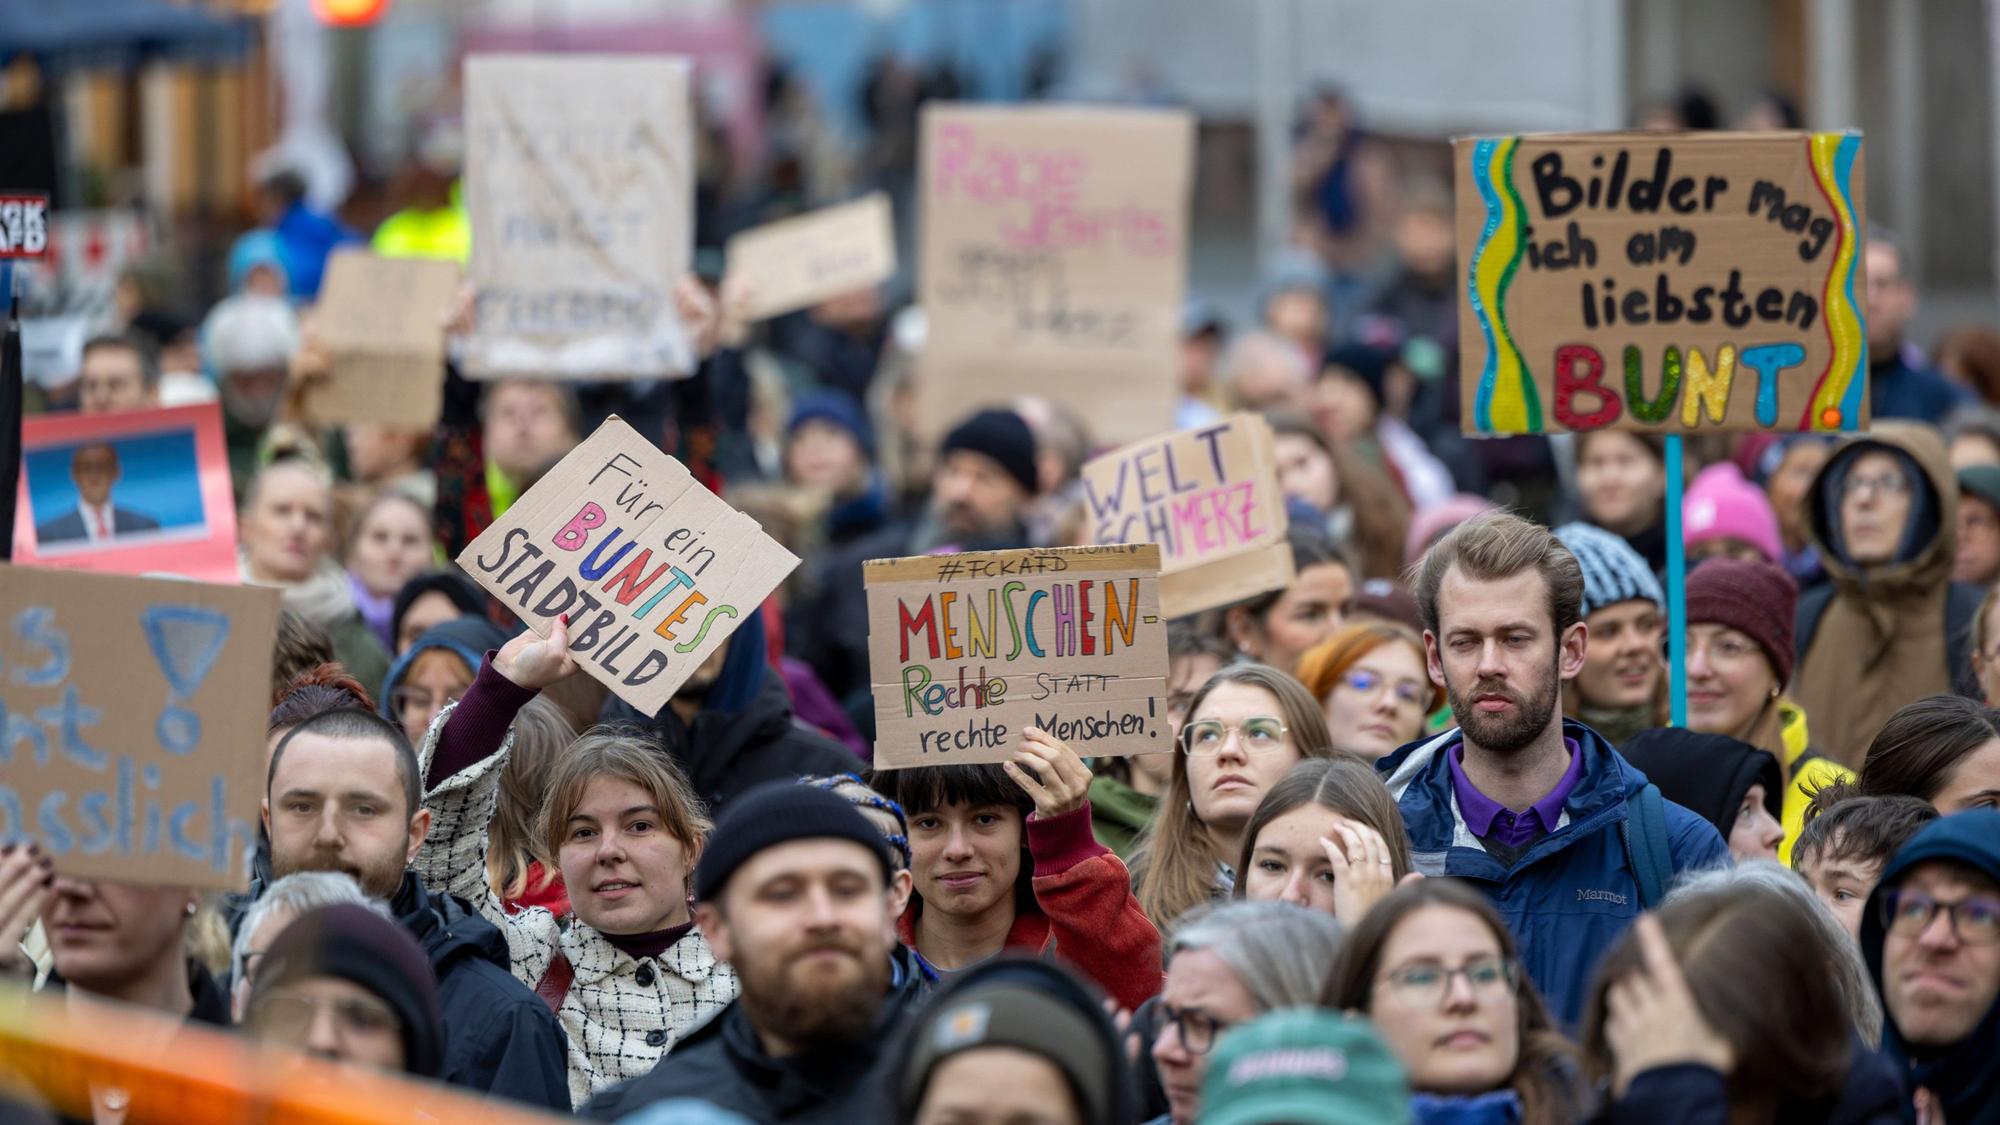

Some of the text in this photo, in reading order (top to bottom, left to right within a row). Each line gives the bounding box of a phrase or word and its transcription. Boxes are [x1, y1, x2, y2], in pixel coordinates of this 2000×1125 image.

[1531, 147, 1834, 262] Bilder mag
[1524, 221, 1696, 271] ich am
[1581, 269, 1819, 330] liebsten
[1083, 422, 1233, 521] WELT
[588, 452, 717, 577] Für ein
[551, 500, 739, 654] BUNTES
[937, 555, 1069, 583] #FCKAFD
[477, 527, 669, 687] STADTBILD
[897, 577, 1159, 664] MENSCHEN-
[901, 663, 1120, 718] Rechte STATT
[919, 695, 1158, 753] rechte Menschen!
[1576, 888, 1628, 905] Marmot
